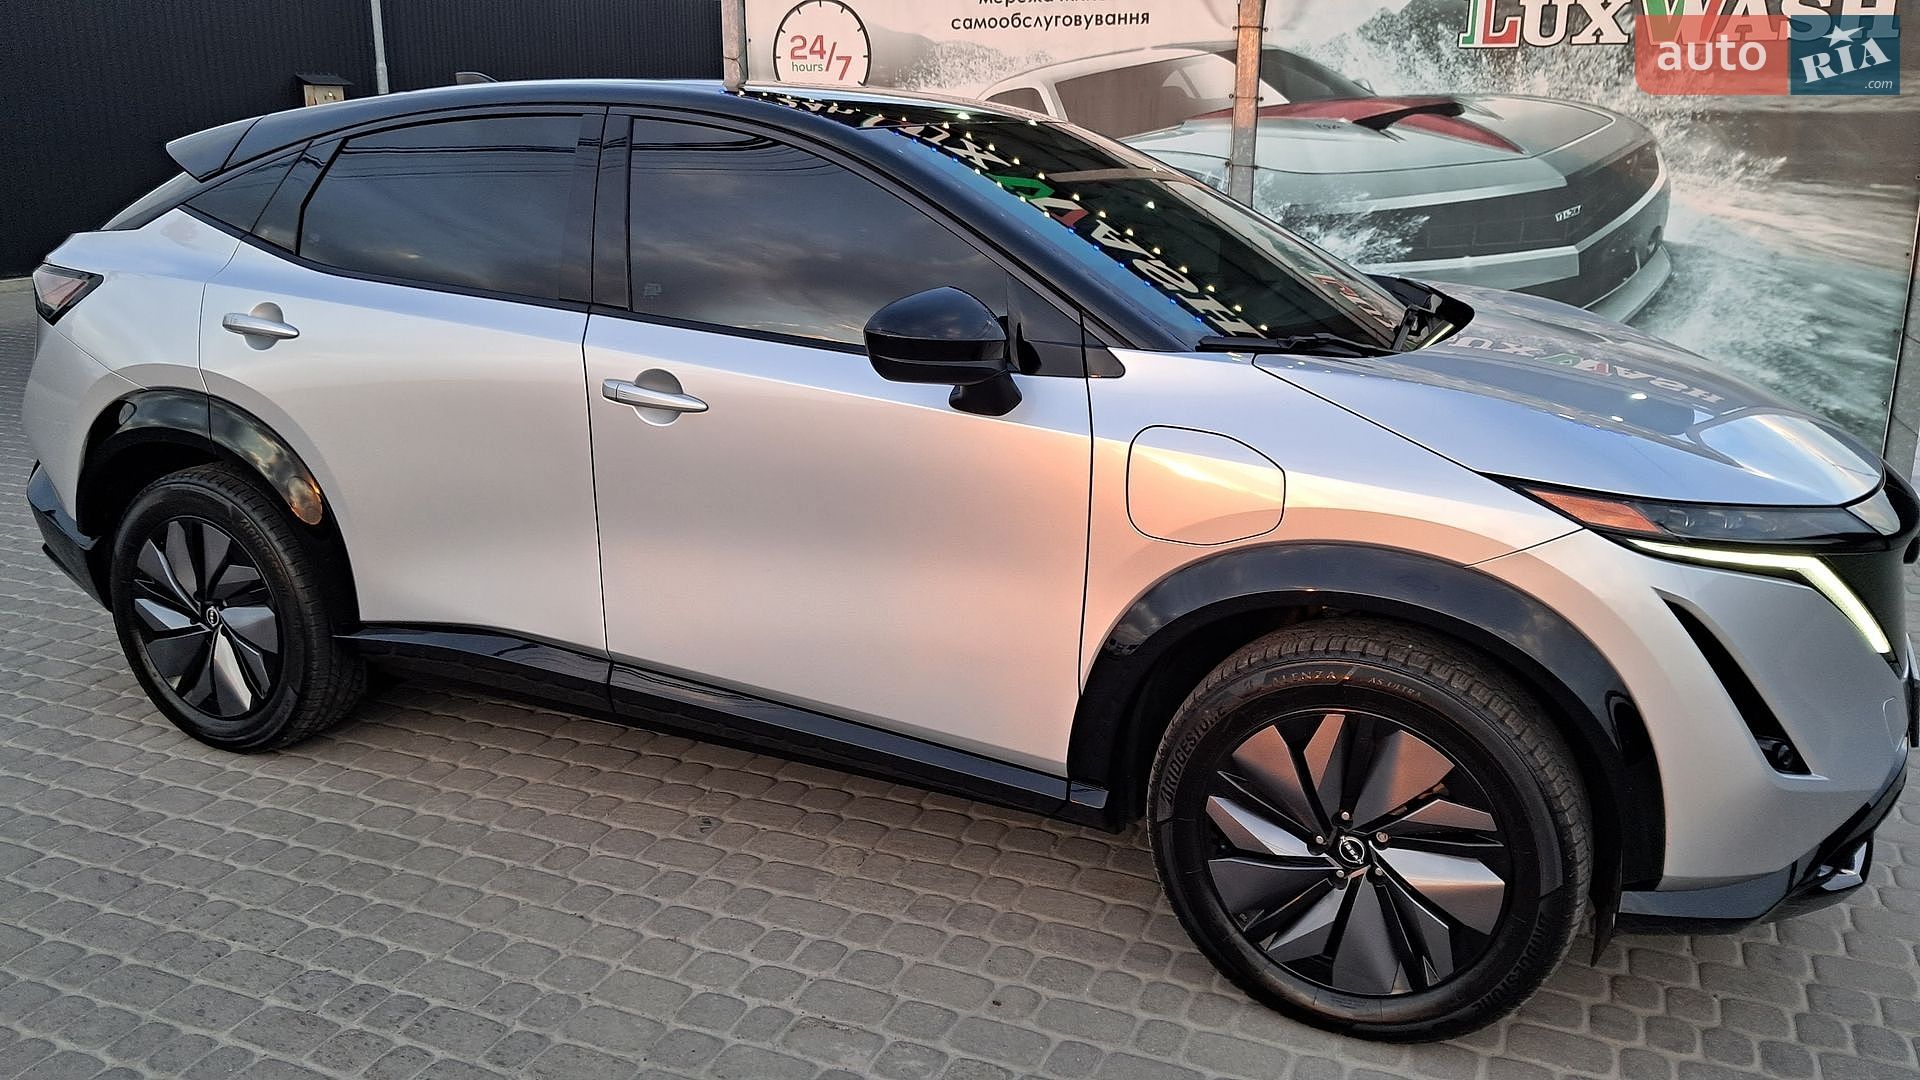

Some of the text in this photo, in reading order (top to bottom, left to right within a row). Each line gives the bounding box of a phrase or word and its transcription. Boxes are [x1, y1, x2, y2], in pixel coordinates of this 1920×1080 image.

[951, 12, 1150, 31] самообслуговування
[790, 34, 853, 81] 24/7
[791, 61, 824, 72] hours
